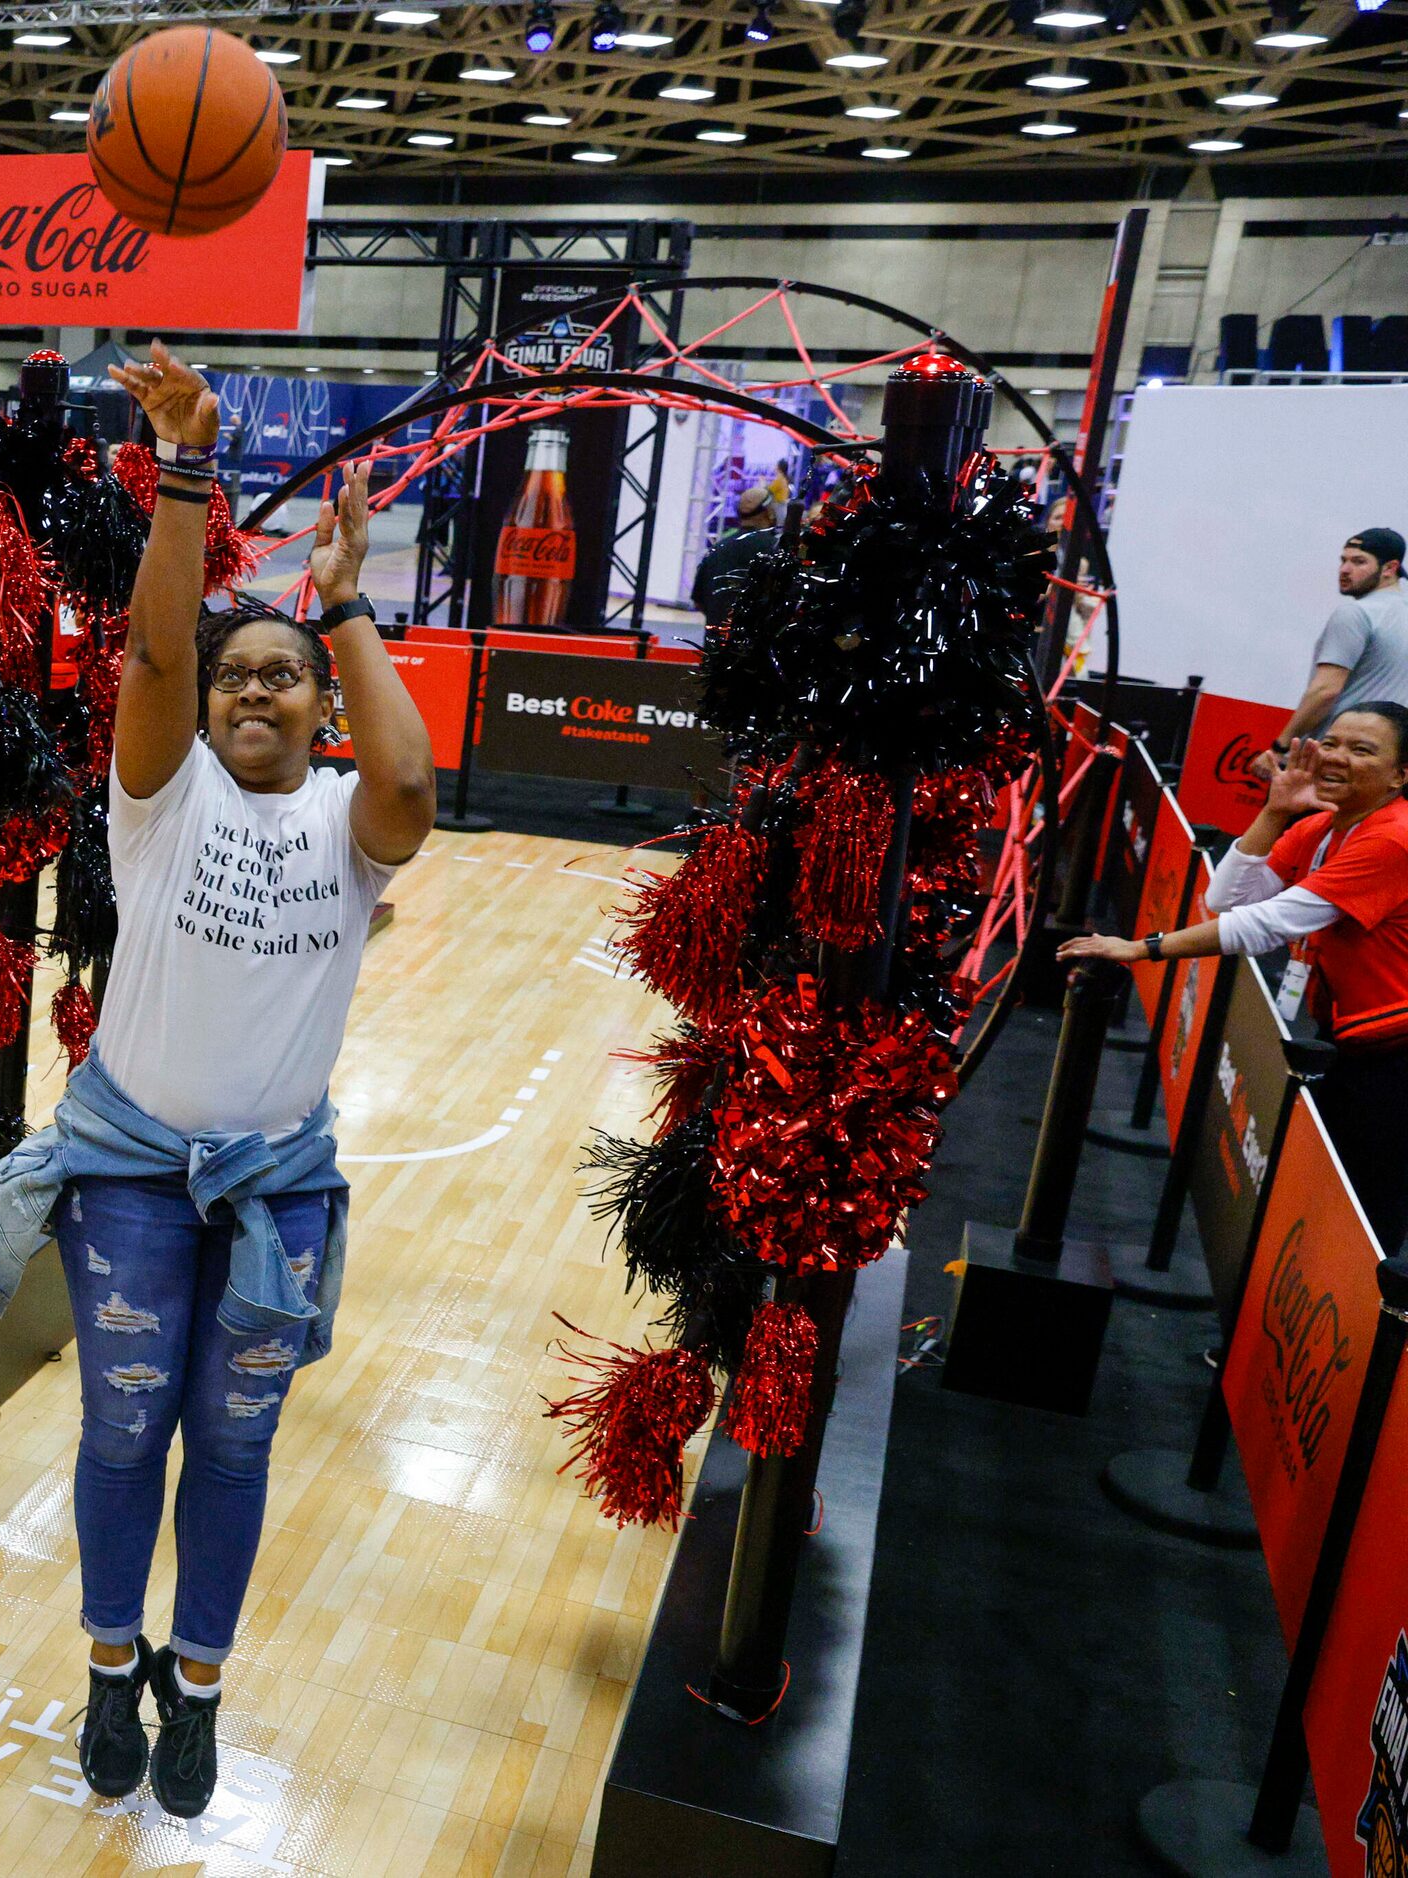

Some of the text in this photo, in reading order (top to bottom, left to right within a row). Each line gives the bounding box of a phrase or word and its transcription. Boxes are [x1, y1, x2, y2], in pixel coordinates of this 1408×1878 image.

[31, 281, 109, 298] SUGAR
[509, 345, 607, 369] FINAL FOUR
[501, 529, 571, 562] Coca-Cola
[506, 692, 568, 716] Best
[570, 695, 634, 723] Coke
[560, 725, 651, 745] #takeataste
[194, 859, 224, 892] but
[230, 879, 270, 904] she
[184, 889, 267, 929] a break
[174, 914, 339, 955] so she said NO
[1263, 1217, 1354, 1471] Coca-Cola
